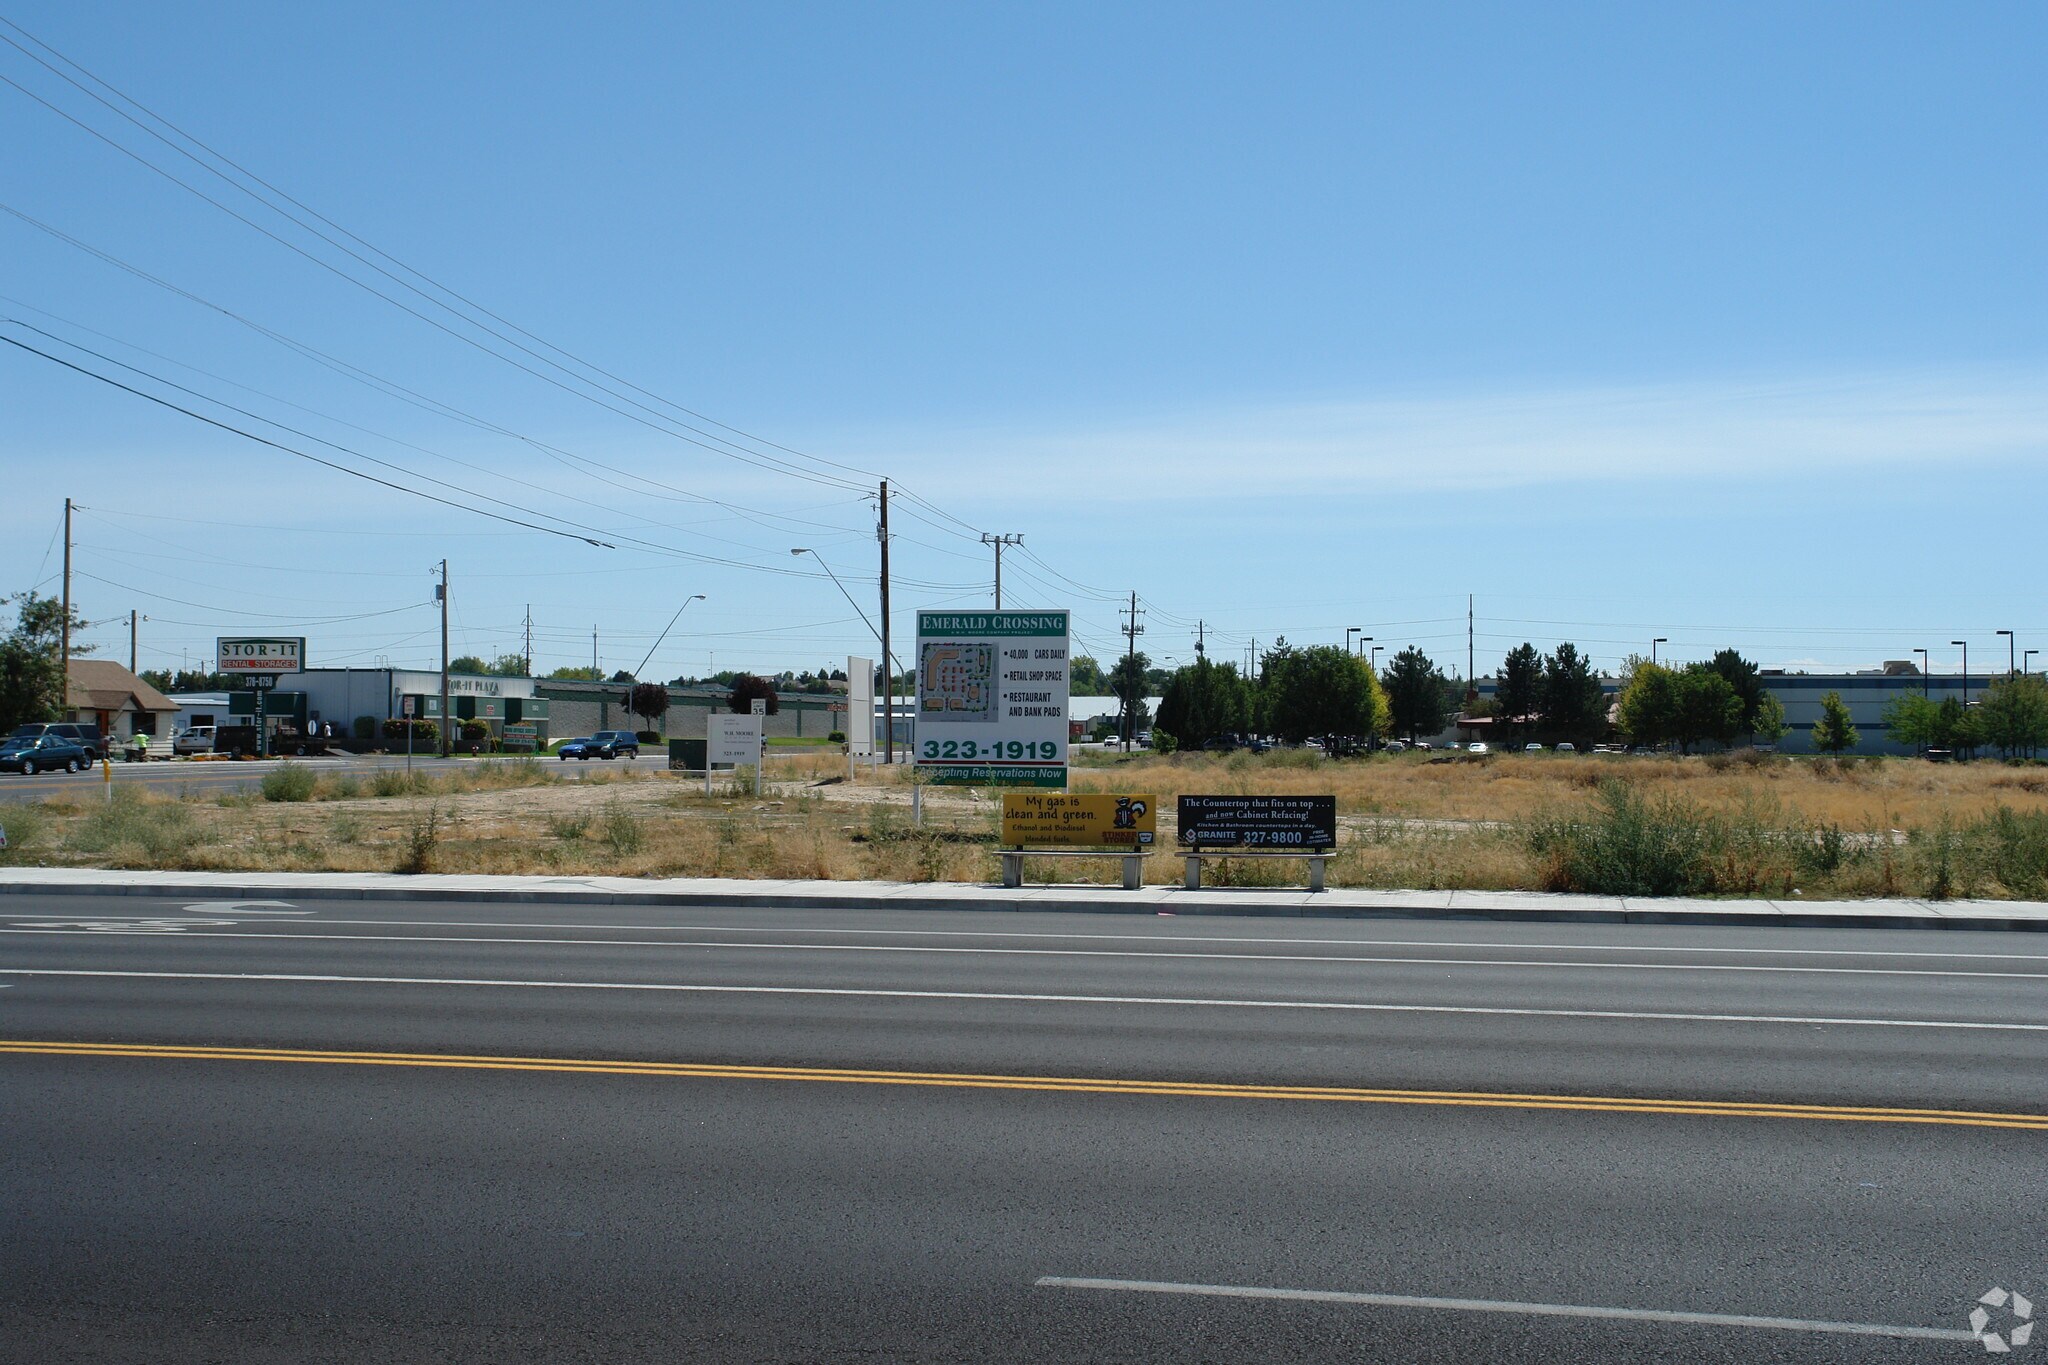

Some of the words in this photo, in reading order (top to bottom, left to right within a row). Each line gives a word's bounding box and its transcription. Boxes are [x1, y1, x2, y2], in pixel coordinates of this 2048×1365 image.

[923, 616, 987, 629] EMERALD
[992, 616, 1063, 629] CROSSING
[222, 645, 297, 656] STOR-IT
[1009, 649, 1028, 660] 40,000
[1035, 649, 1049, 659] CARS
[1050, 649, 1065, 659] DAILY
[222, 660, 250, 668] RENTAL
[255, 660, 297, 668] STORAGES
[1009, 671, 1028, 681] RETAIL
[1029, 671, 1044, 681] SHOP
[1045, 671, 1062, 681] SPACE
[475, 681, 499, 691] PLAZA
[1009, 692, 1051, 702] RESTAURANT
[1009, 707, 1023, 717] AND
[1024, 707, 1042, 717] BANK
[1043, 707, 1061, 717] PADS
[255, 690, 263, 751] www.stor-it.com
[923, 740, 1057, 760] 323-1919
[972, 768, 1036, 778] Reservations
[1039, 769, 1062, 778] Now
[1026, 796, 1042, 810] My
[1047, 797, 1066, 810] gas
[1070, 796, 1080, 806] is
[1185, 798, 1201, 807] The
[1203, 798, 1249, 809] Countertop
[1252, 799, 1269, 807] that
[1271, 798, 1284, 807] fits
[1299, 799, 1313, 809] top
[1005, 809, 1033, 819] clean
[1037, 809, 1058, 819] and
[1063, 811, 1097, 823] green.
[1236, 811, 1268, 819] Cabinet
[1271, 811, 1309, 821] Refacing!
[1244, 831, 1302, 843] 327-9800
